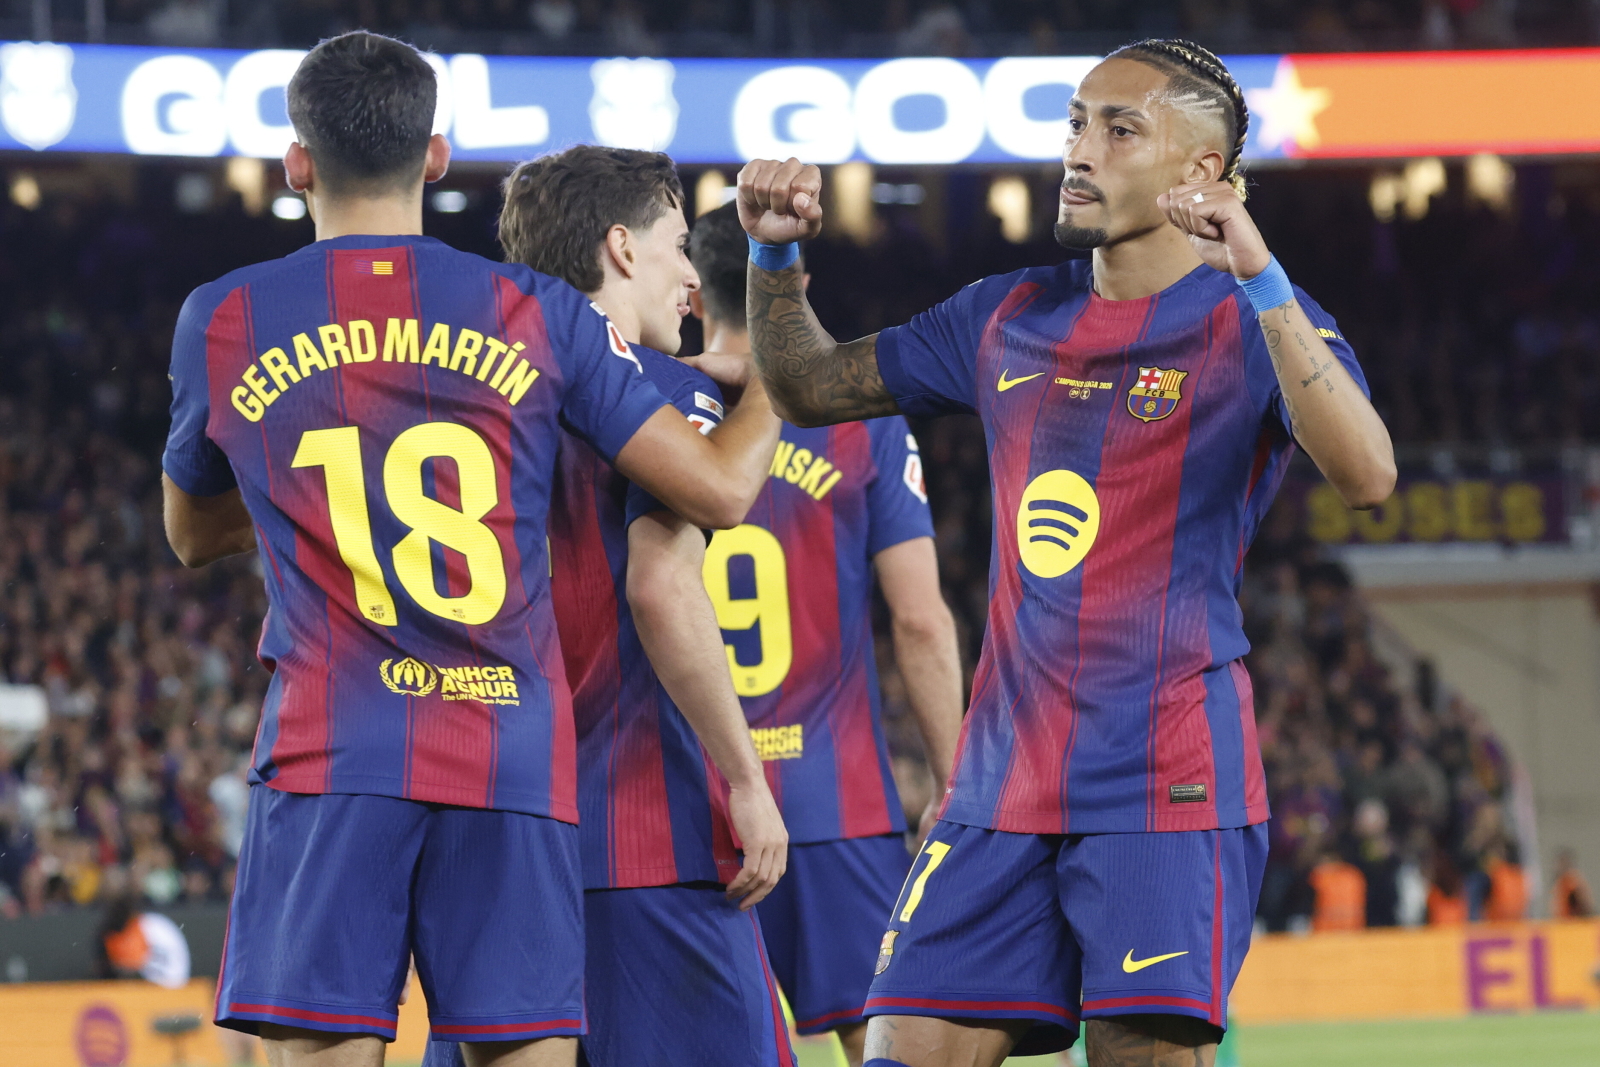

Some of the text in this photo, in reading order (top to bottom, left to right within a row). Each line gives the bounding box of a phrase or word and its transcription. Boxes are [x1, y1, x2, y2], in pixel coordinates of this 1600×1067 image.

[120, 49, 550, 157] GOL
[230, 317, 541, 423] GERARD MARTÍN
[1144, 388, 1166, 398] FCB
[290, 421, 507, 627] 18
[698, 524, 792, 697] 9
[1466, 934, 1586, 1014] EL
